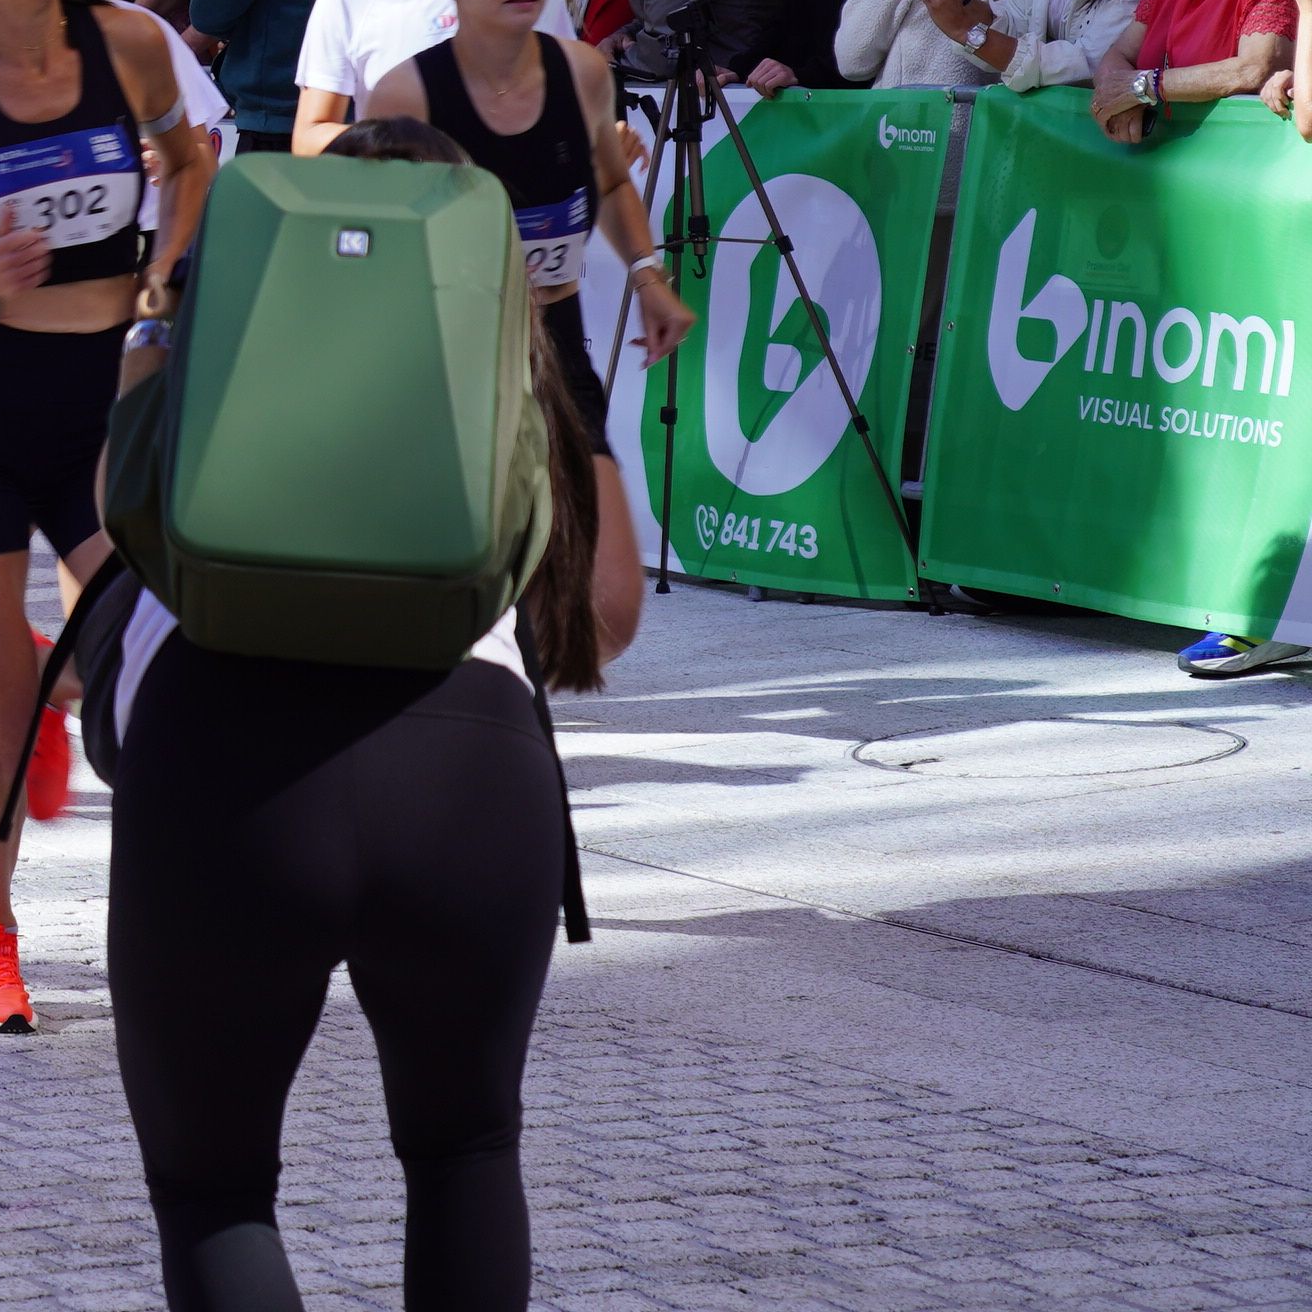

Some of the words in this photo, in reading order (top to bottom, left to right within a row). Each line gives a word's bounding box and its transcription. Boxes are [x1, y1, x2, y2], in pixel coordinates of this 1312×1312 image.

[30, 183, 110, 234] 302
[525, 243, 569, 273] 03
[986, 206, 1296, 412] binomi
[1078, 394, 1154, 431] VISUAL
[1158, 404, 1284, 448] SOLUTIONS
[719, 512, 761, 551] 841
[765, 519, 819, 560] 743
